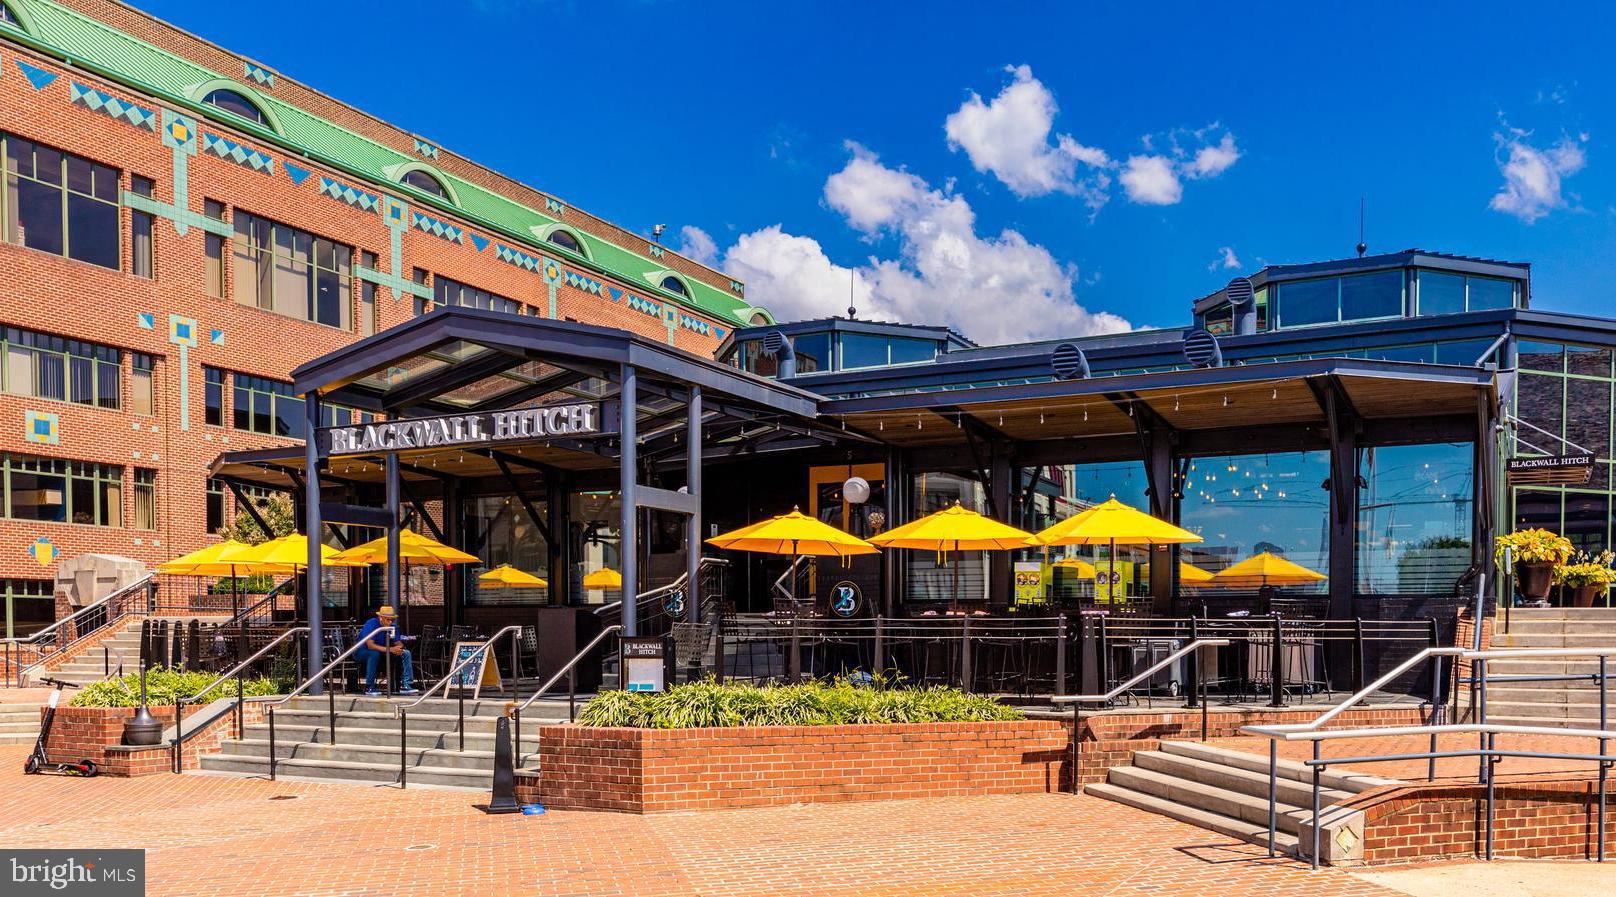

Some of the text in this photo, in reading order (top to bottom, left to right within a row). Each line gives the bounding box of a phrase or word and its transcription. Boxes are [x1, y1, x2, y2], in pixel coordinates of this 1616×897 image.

[330, 403, 599, 454] BLACKWALL HITCH
[1510, 456, 1590, 468] BLACKWALL HITCH
